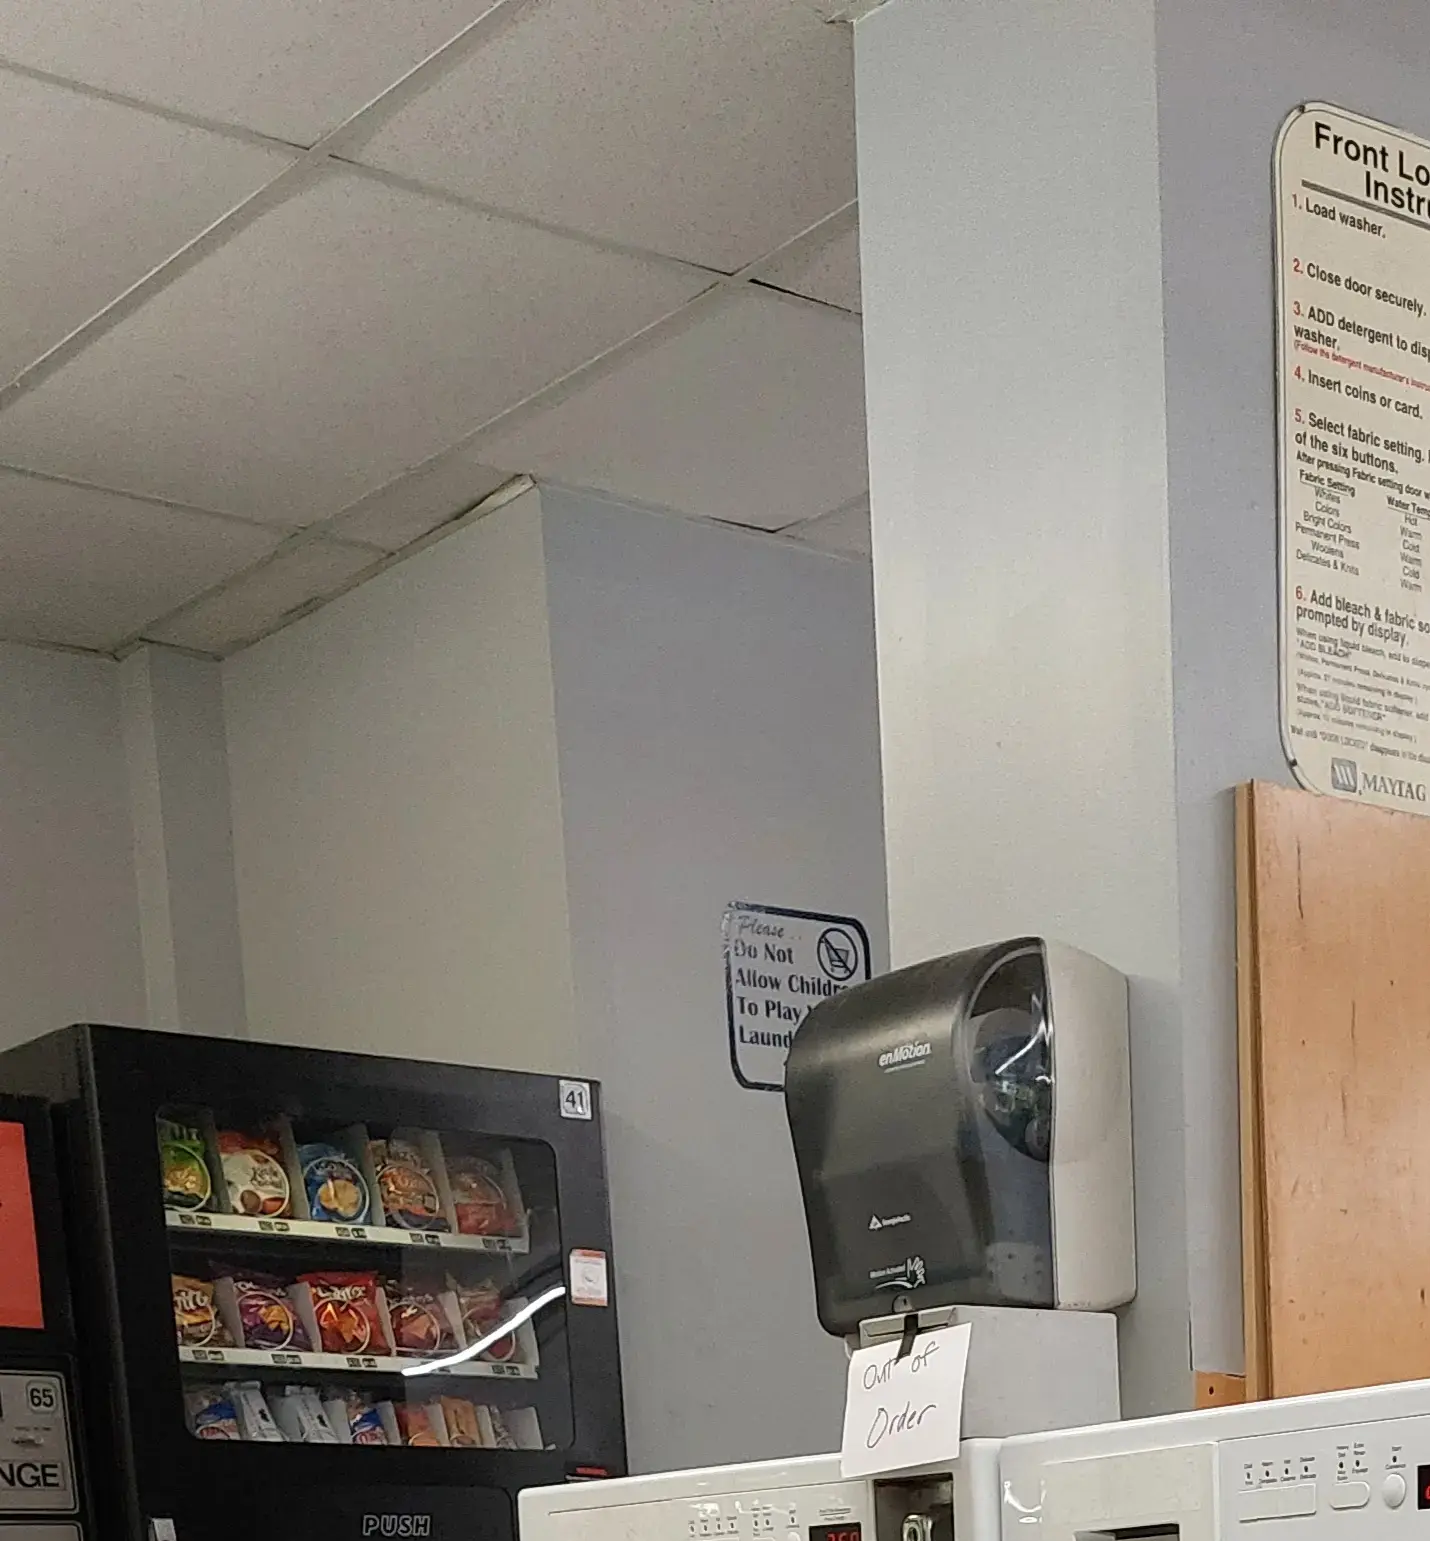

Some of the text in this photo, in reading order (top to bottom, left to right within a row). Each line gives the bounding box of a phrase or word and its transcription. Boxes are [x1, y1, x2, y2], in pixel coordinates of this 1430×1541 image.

[1315, 121, 1389, 173] Front
[1292, 193, 1386, 239] 1. Load washer.
[1293, 257, 1427, 318] 2. Close door securely.
[1293, 300, 1304, 317] 3.
[1307, 305, 1335, 326] ADD
[1338, 316, 1393, 348] detergent
[1396, 335, 1408, 351] to
[1293, 324, 1341, 351] washer.
[1294, 365, 1423, 420] 4. Insert coins or card.
[1294, 408, 1305, 425] 5.
[1308, 412, 1345, 437] Select
[1347, 424, 1381, 448] fabric
[1383, 439, 1425, 464] setting.
[1295, 431, 1398, 475] of the six buttons.
[1295, 584, 1306, 601] 6.
[1310, 589, 1333, 609] Add
[1335, 595, 1371, 619] bleach
[1374, 605, 1382, 622] &
[1384, 608, 1416, 630] fabric
[1296, 605, 1410, 649] prompted by display.
[1361, 771, 1427, 802] MAYTAG
[734, 939, 794, 964] Do Not
[736, 967, 848, 997] Allow Childr
[736, 996, 802, 1026] To Play
[739, 1025, 793, 1048] Laund
[565, 1090, 584, 1109] 41
[911, 1340, 940, 1373] of
[29, 1387, 54, 1408] 65
[866, 1400, 937, 1449] Order
[362, 1514, 432, 1537] PUSH
